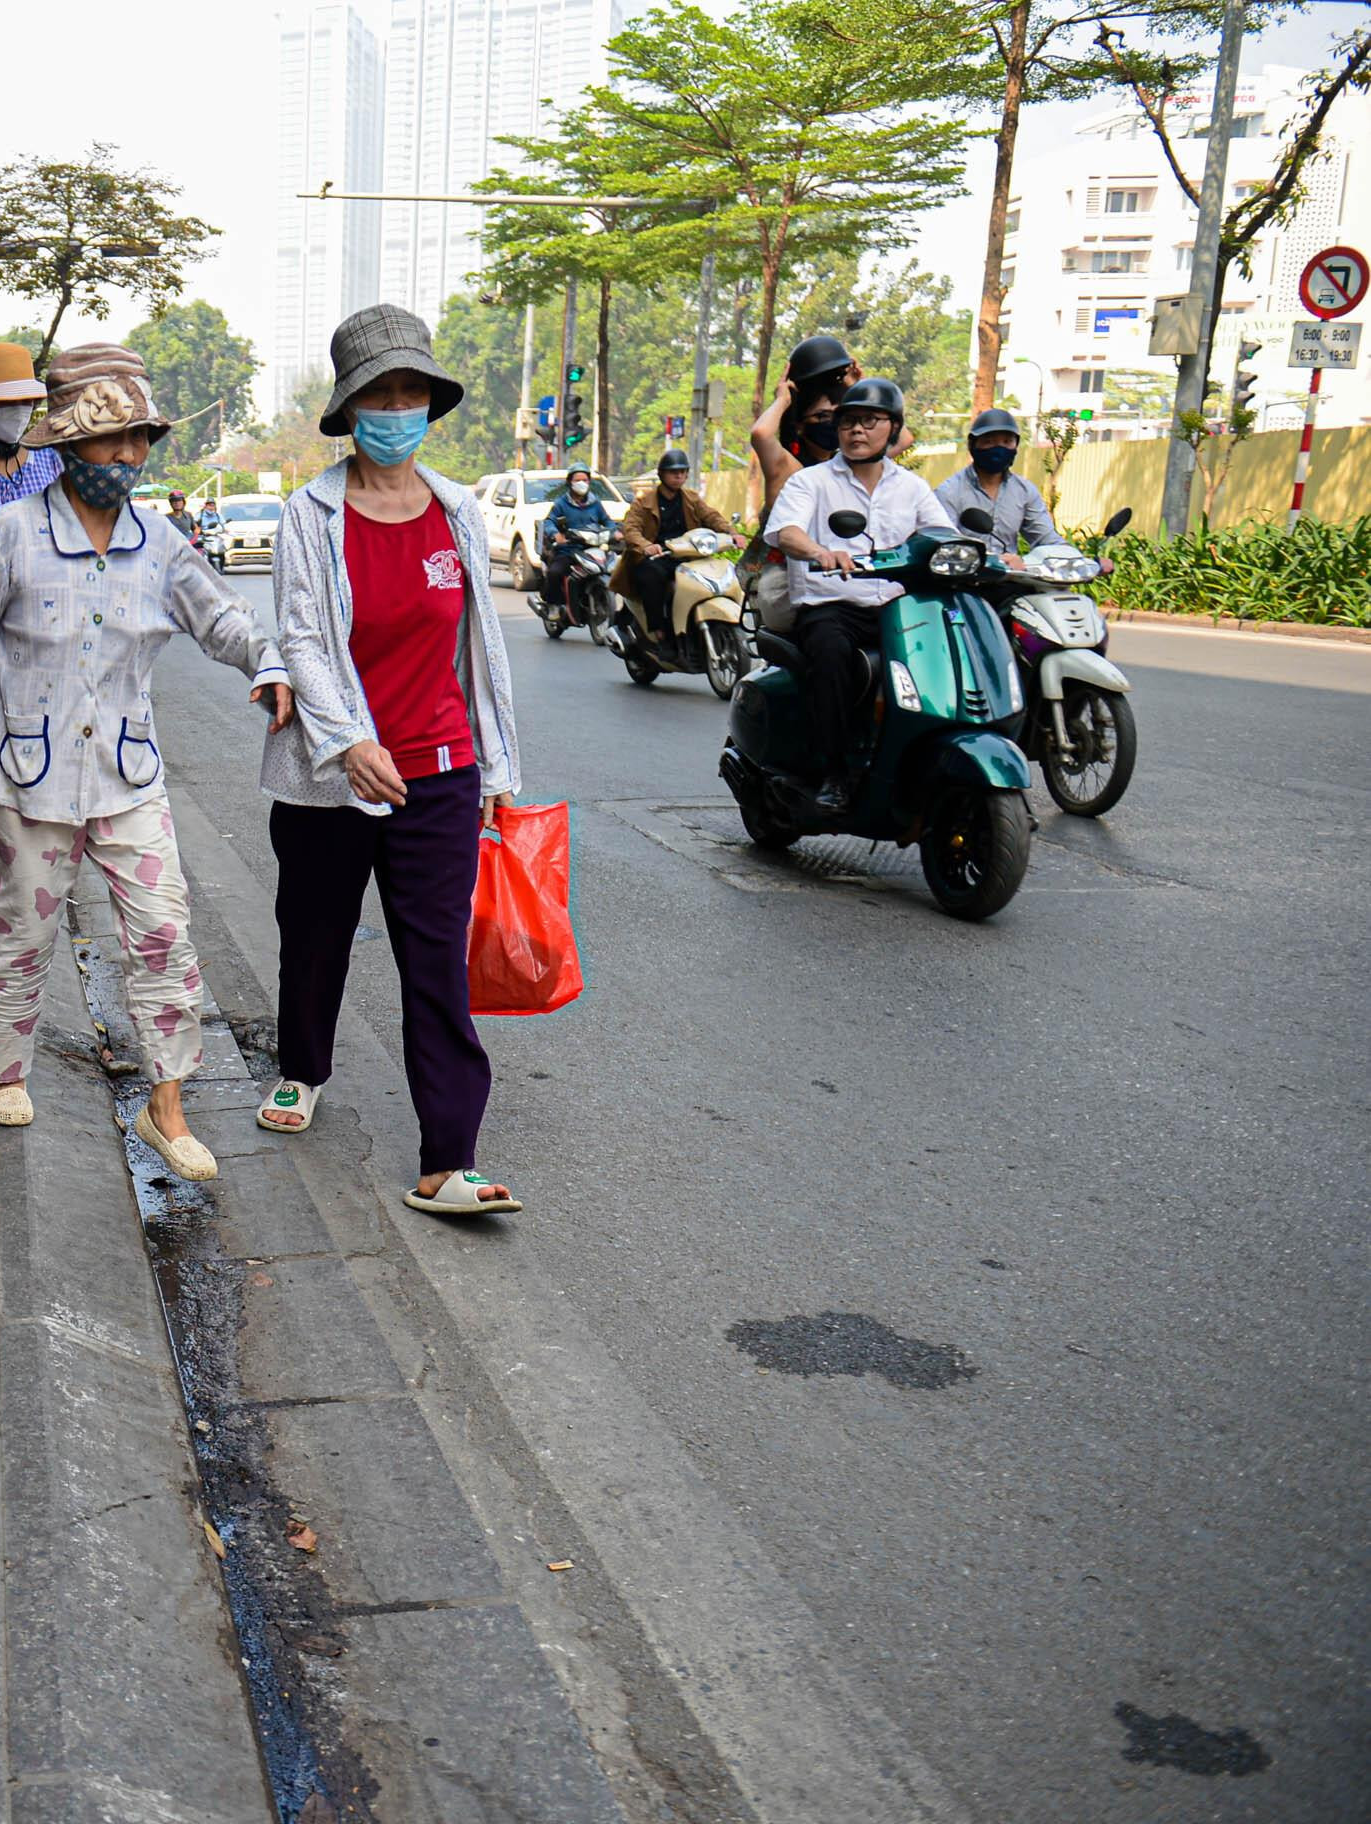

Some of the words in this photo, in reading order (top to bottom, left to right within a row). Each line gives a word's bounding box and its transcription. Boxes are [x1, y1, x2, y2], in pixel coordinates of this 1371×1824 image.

[1303, 328, 1323, 341] 6:00
[1331, 329, 1351, 342] 9:00
[1295, 349, 1320, 361] 16:30
[1329, 350, 1352, 362] 19:30
